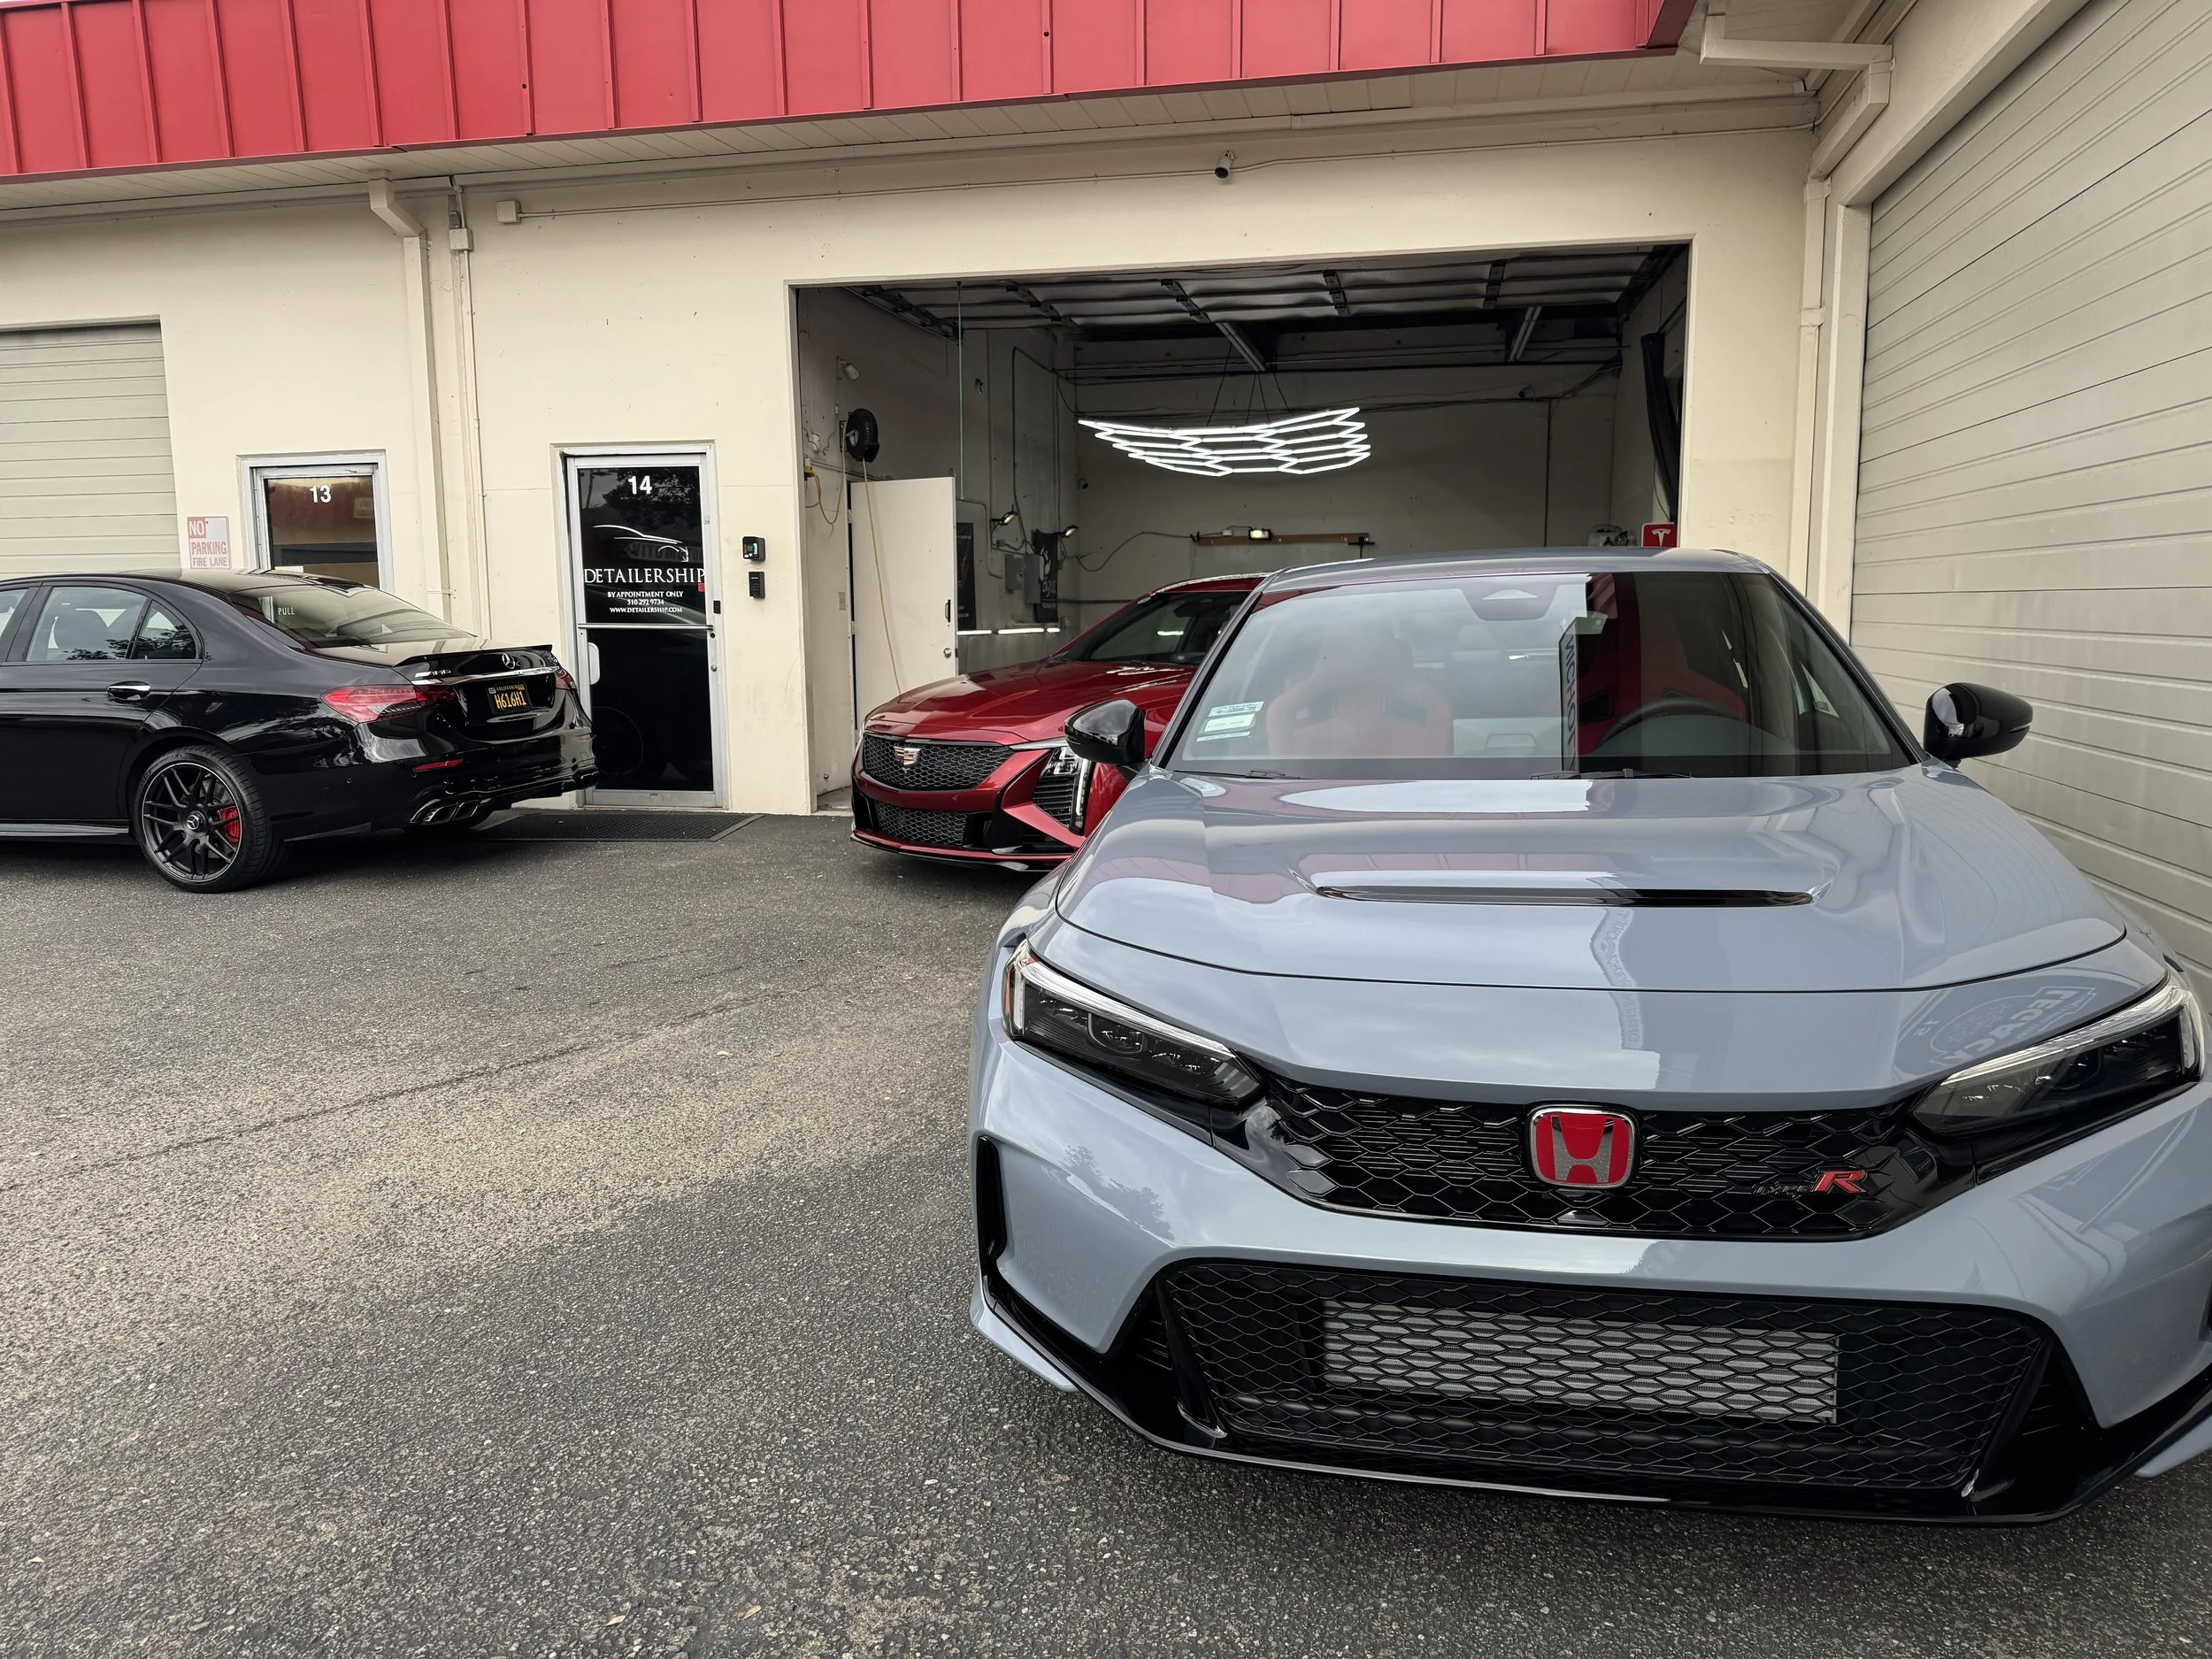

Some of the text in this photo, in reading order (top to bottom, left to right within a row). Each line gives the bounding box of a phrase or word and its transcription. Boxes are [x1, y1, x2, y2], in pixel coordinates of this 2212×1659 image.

[627, 475, 653, 495] 14
[309, 485, 332, 503] 13
[188, 520, 205, 536] NO
[191, 541, 227, 555] PARKING
[192, 557, 227, 566] FIRE LANE
[584, 568, 705, 583] DETAILERSHIP
[278, 607, 296, 616] PULL
[494, 691, 526, 709] H616H1
[1813, 1169, 1868, 1194] R
